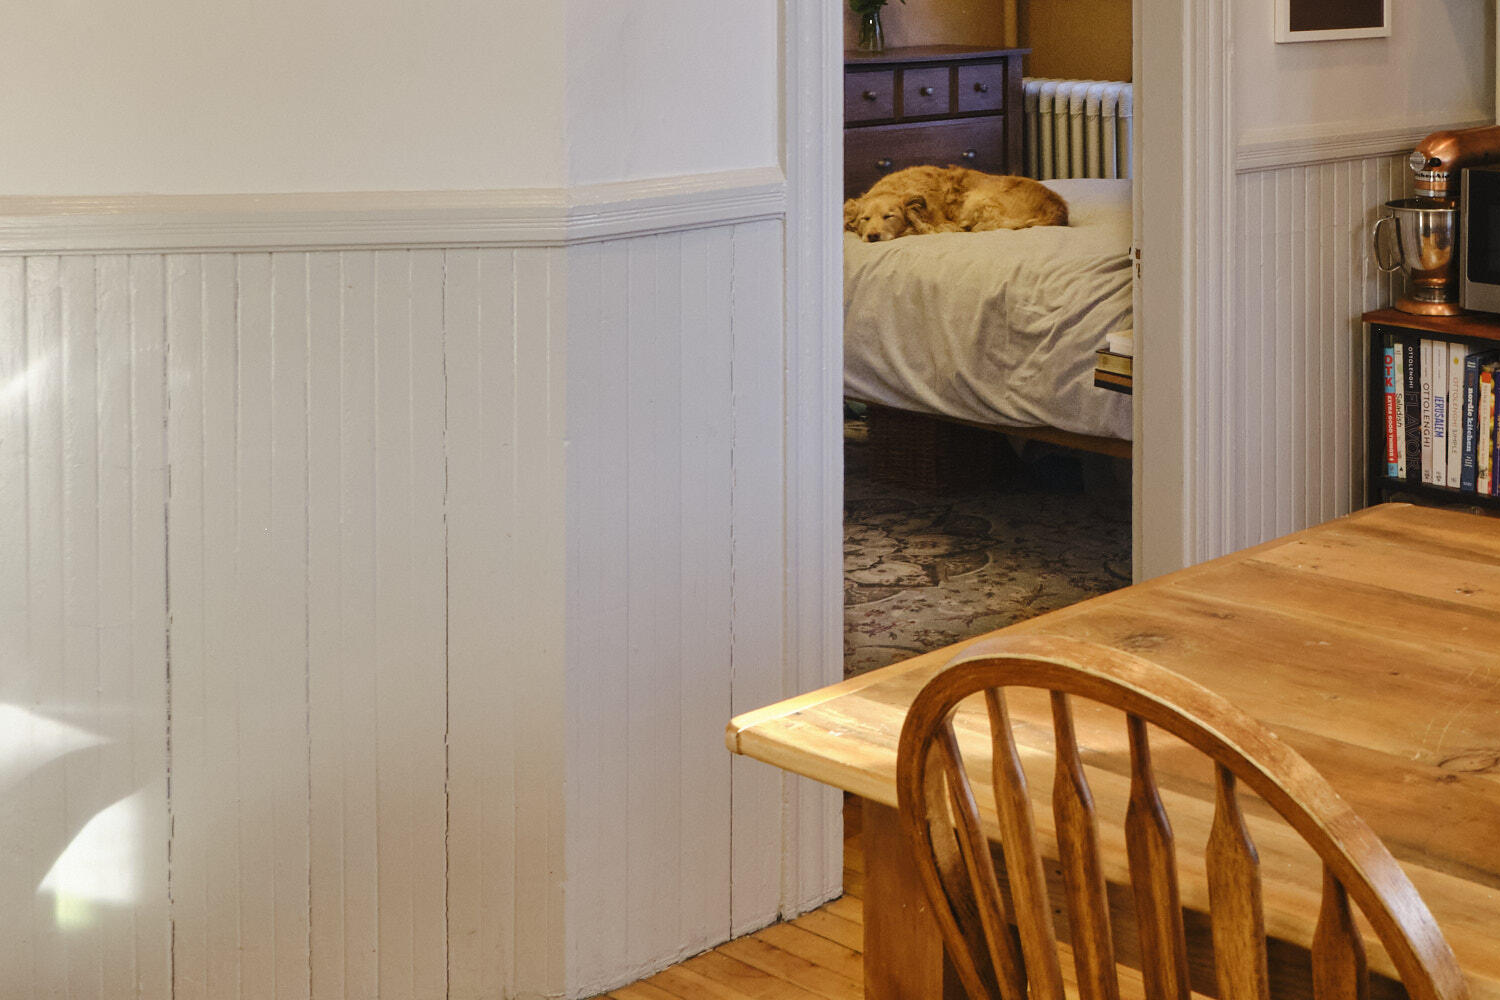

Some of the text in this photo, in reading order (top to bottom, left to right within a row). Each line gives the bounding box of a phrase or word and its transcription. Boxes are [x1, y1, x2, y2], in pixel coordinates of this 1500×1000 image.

[1384, 354, 1393, 387] OTK
[1396, 393, 1404, 427] Saladish
[1423, 382, 1431, 448] OTTOLENGHI
[1434, 395, 1445, 438] JERUSALEM
[1405, 392, 1420, 472] FLAVOR
[1466, 417, 1474, 452] kitchen
